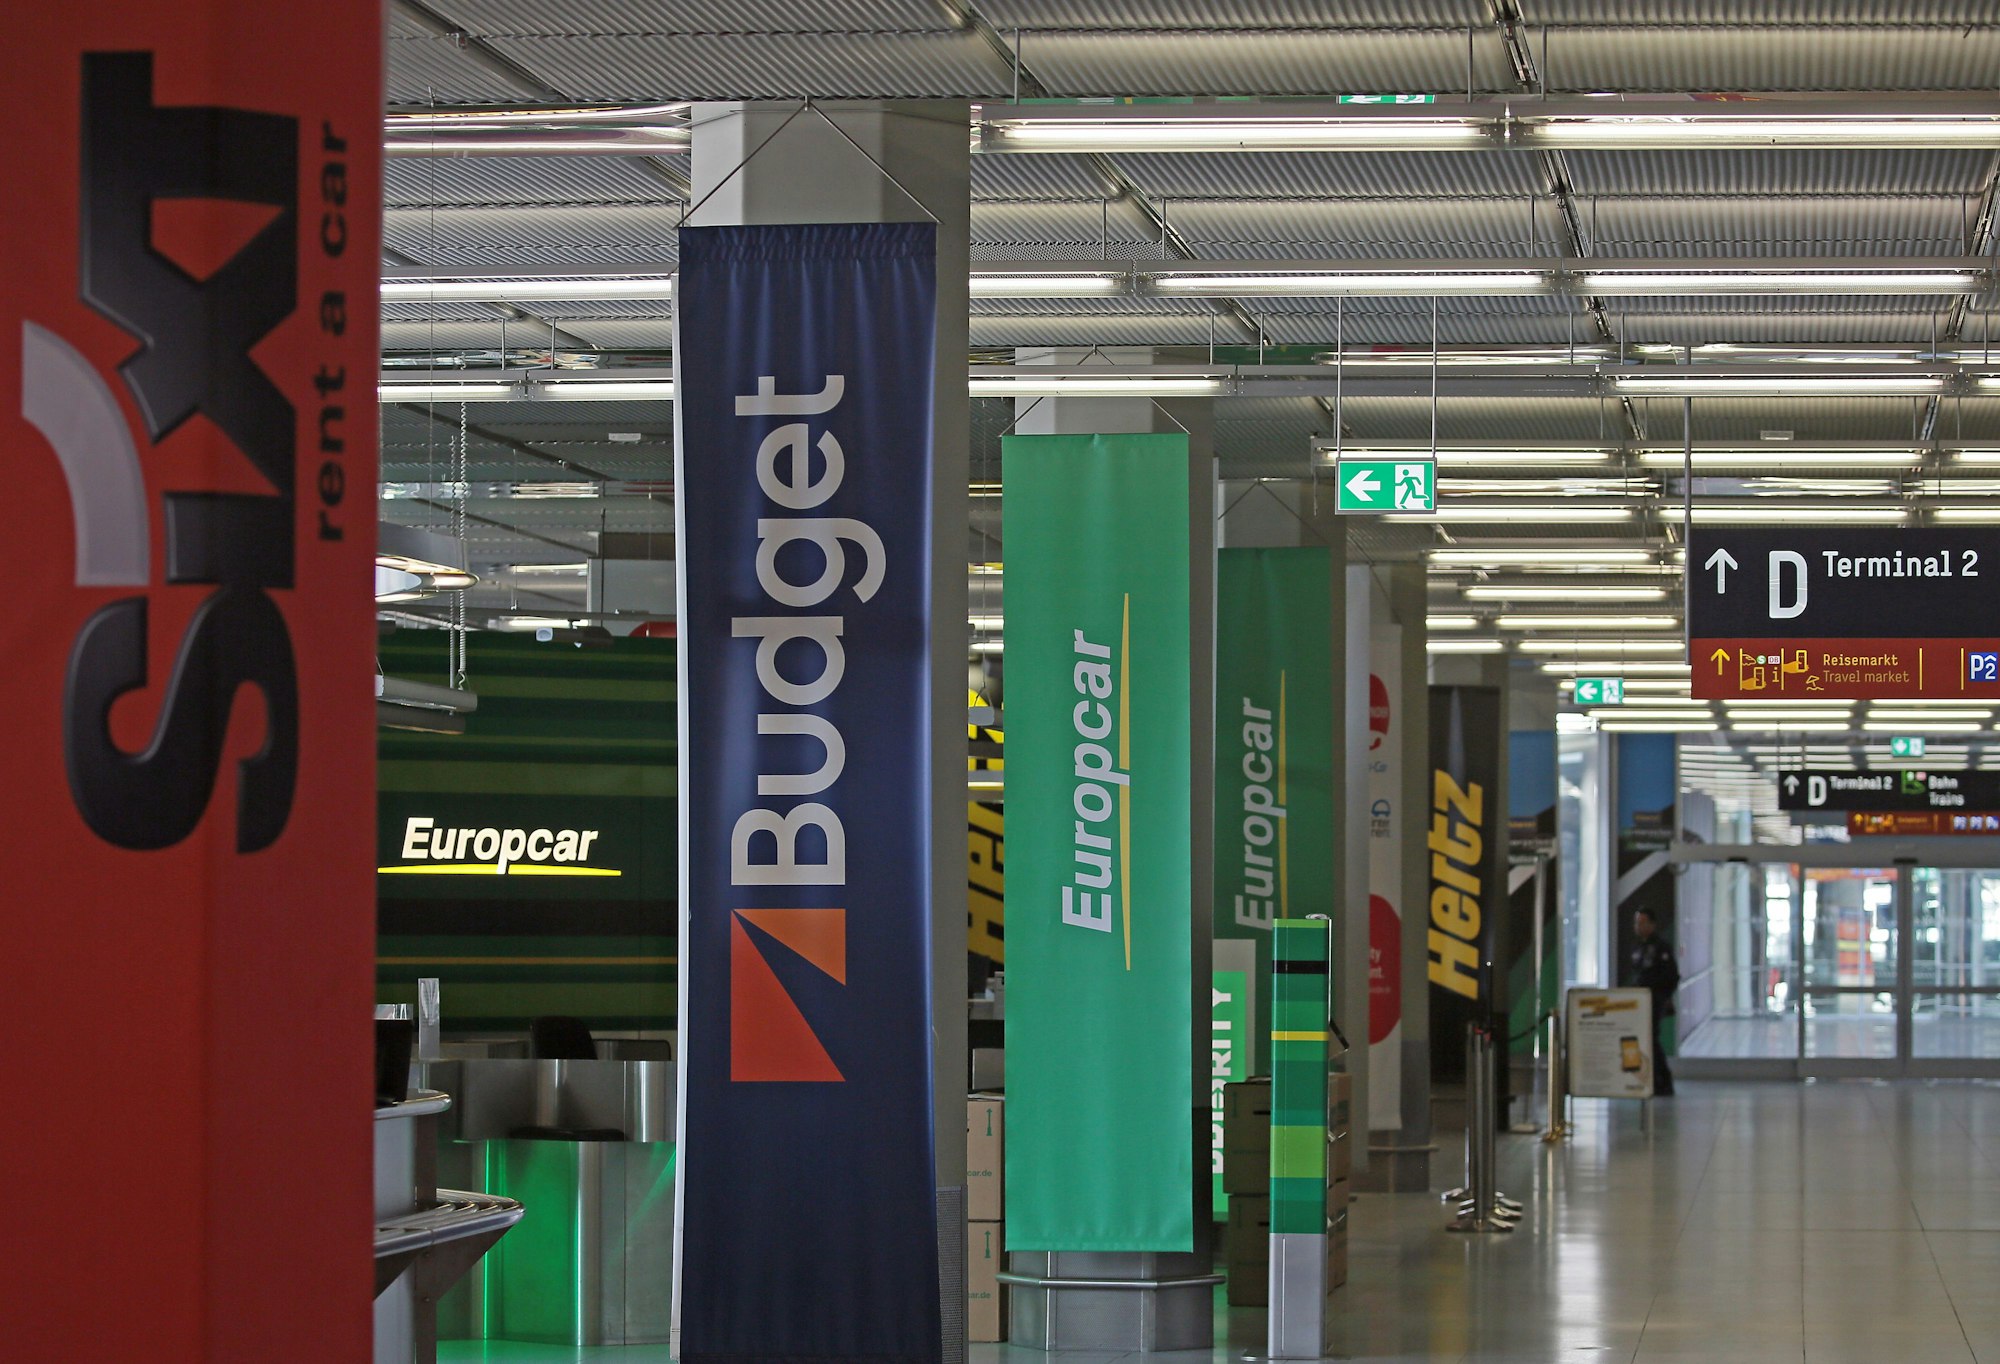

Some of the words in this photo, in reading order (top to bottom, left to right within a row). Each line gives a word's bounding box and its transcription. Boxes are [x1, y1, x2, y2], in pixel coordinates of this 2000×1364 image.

[317, 121, 349, 259] car
[317, 290, 347, 333] a
[317, 366, 346, 541] rent
[1768, 550, 1808, 620] D
[1822, 550, 1953, 578] Terminal
[1961, 549, 1980, 578] 2
[730, 374, 887, 887] Budget
[1823, 653, 1899, 667] Reisemarkt
[1823, 670, 1861, 684] Travel
[1864, 670, 1910, 684] market
[1970, 654, 1997, 680] P2
[1061, 628, 1131, 933] Europcar
[1807, 775, 1828, 807] D
[1829, 775, 1882, 790] Terminal
[1883, 775, 1893, 790] 2
[1234, 697, 1287, 931] Europcar
[401, 816, 599, 875] Europcar
[1427, 768, 1483, 1001] Hertz
